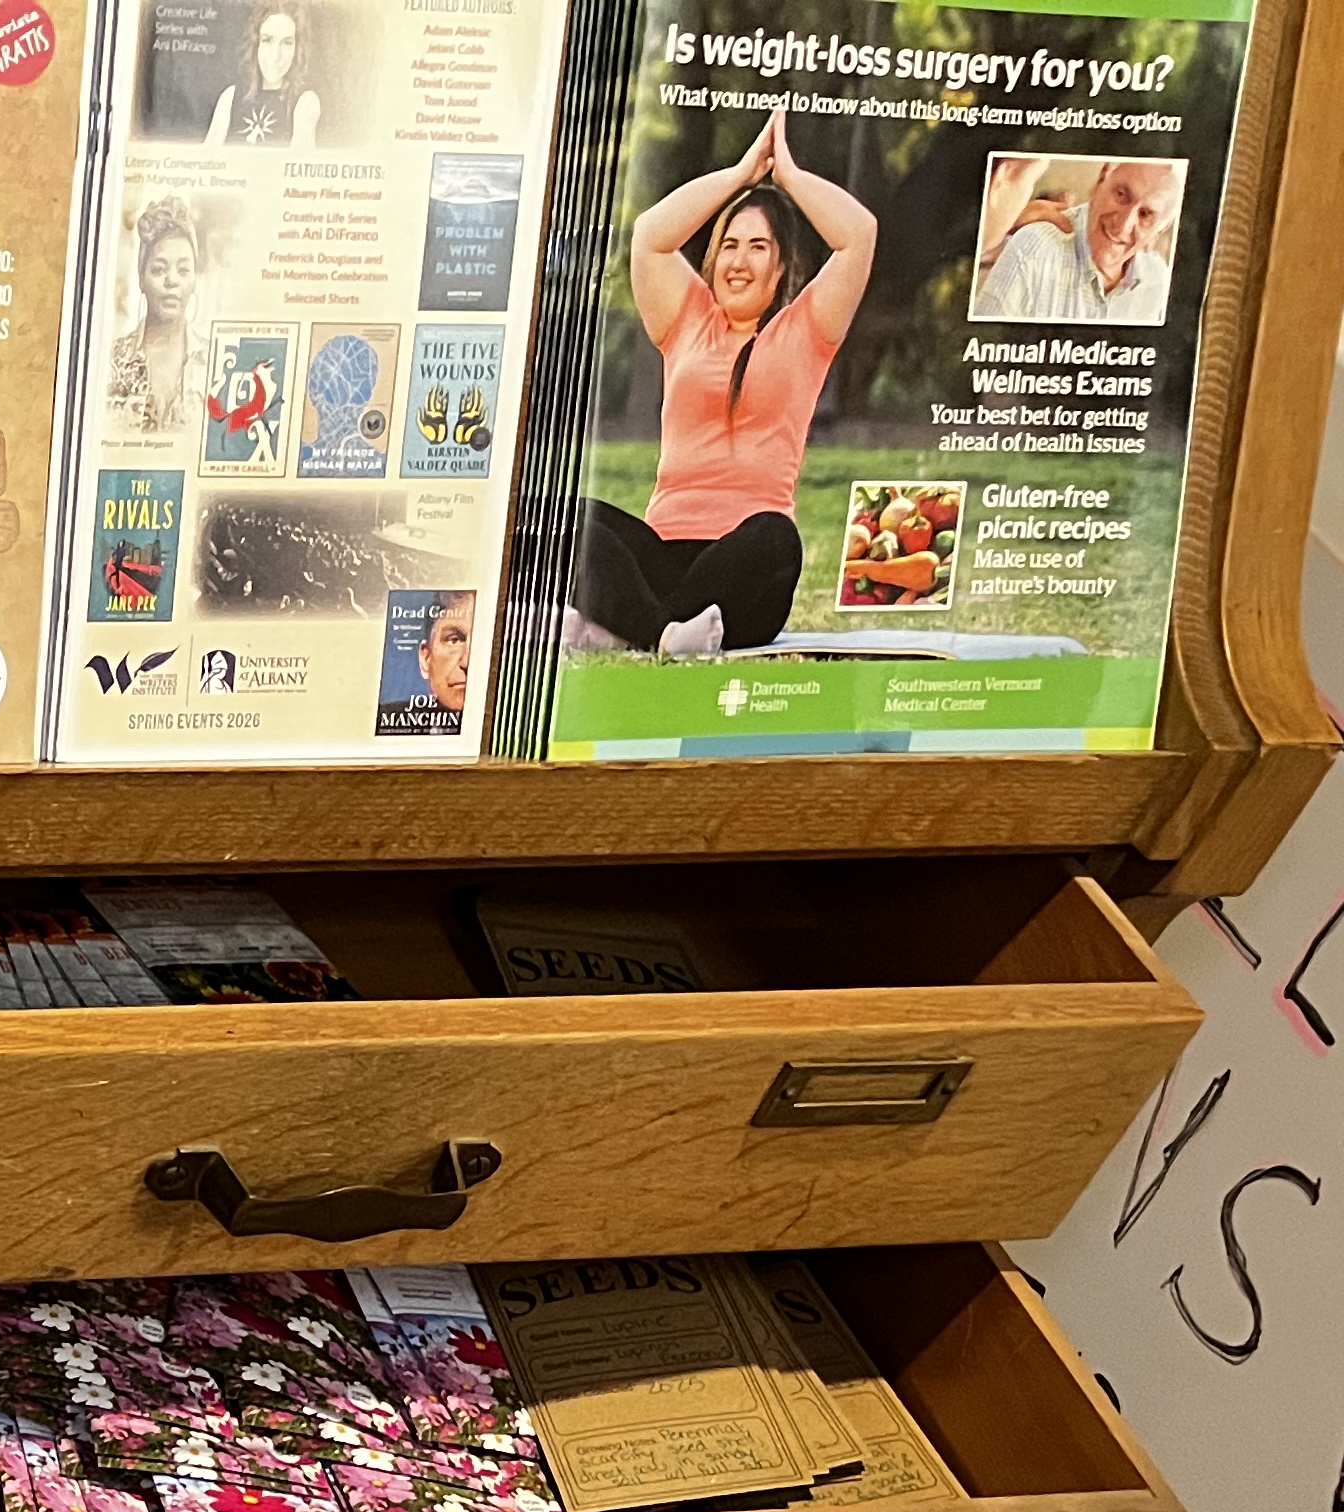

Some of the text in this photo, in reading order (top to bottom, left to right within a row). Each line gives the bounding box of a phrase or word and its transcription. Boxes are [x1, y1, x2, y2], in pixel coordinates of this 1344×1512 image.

[664, 24, 1174, 96] Is weight-loss surgery for you?
[422, 343, 498, 360] THE FIVE
[963, 338, 1156, 366] Annual Medicare
[420, 363, 496, 381] WOUNDS
[972, 369, 1152, 396] Wellness Exams
[131, 480, 151, 496] THE
[982, 484, 1109, 508] Gluten-free
[103, 498, 174, 530] RIVALS
[978, 516, 1131, 544] picnic recipes
[240, 655, 308, 669] UNIVERSITY
[250, 670, 308, 688] ALBANY
[887, 677, 1042, 692] Southwestern Vermont
[753, 680, 820, 696] Dartmouth
[406, 695, 437, 712] JOE
[750, 698, 788, 712] Health
[884, 696, 987, 712] Medical Center
[129, 713, 260, 730] SPRING EVENTS 2026
[380, 711, 459, 728] MANCHIN
[507, 946, 696, 993] SEEDS
[499, 1256, 702, 1321] SEEDS
